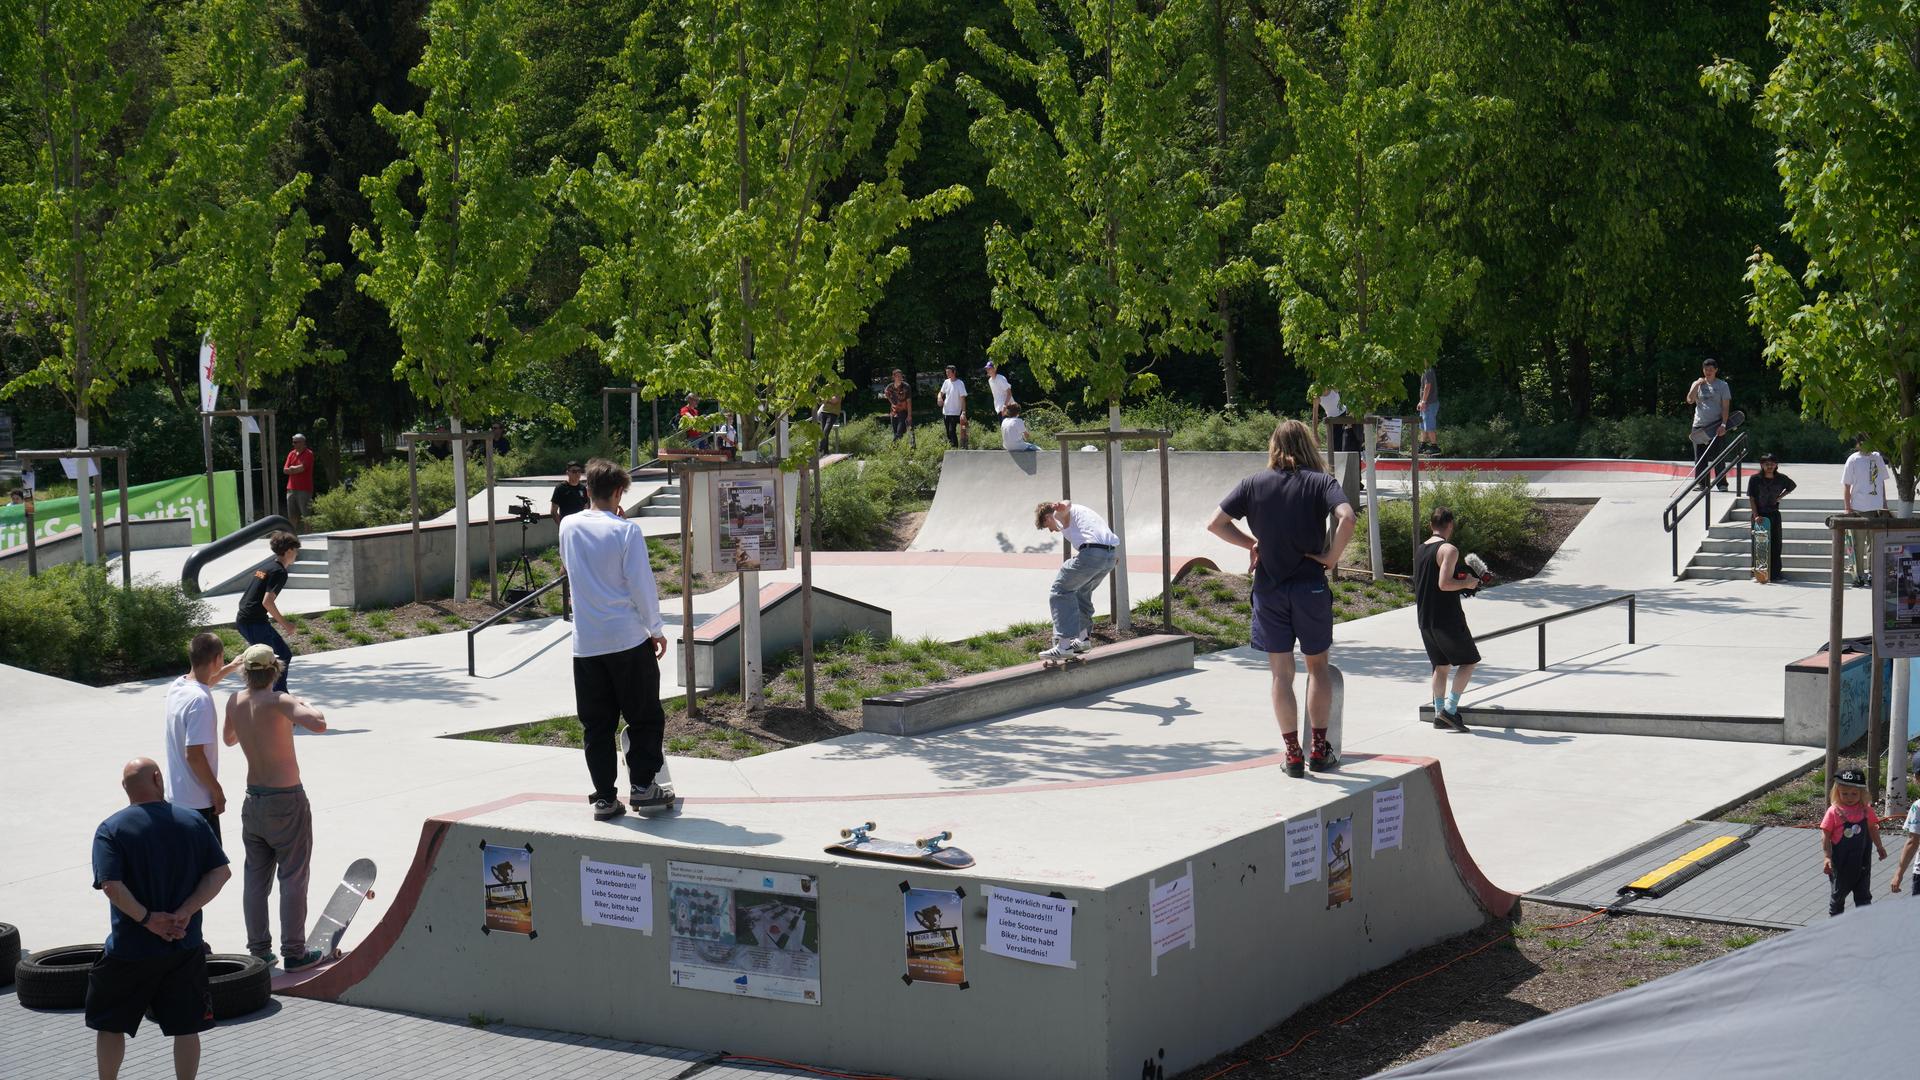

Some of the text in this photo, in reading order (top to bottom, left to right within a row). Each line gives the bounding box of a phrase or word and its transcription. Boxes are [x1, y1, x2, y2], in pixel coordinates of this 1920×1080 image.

[585, 866, 602, 875] Heute
[604, 869, 626, 878] wirklich
[591, 890, 606, 898] Liebe
[607, 892, 629, 900] Scooter
[594, 901, 639, 913] Biker, bitte habt
[994, 893, 1066, 912] Heute wirklich nur für
[599, 912, 634, 922] Verständnis!
[1004, 907, 1053, 922] Skateboards!!!
[999, 918, 1016, 927] Liebe
[1017, 921, 1043, 933] Scooter
[1001, 930, 1055, 947] Biker, bitte habt
[1006, 944, 1048, 957] Verständnis!
